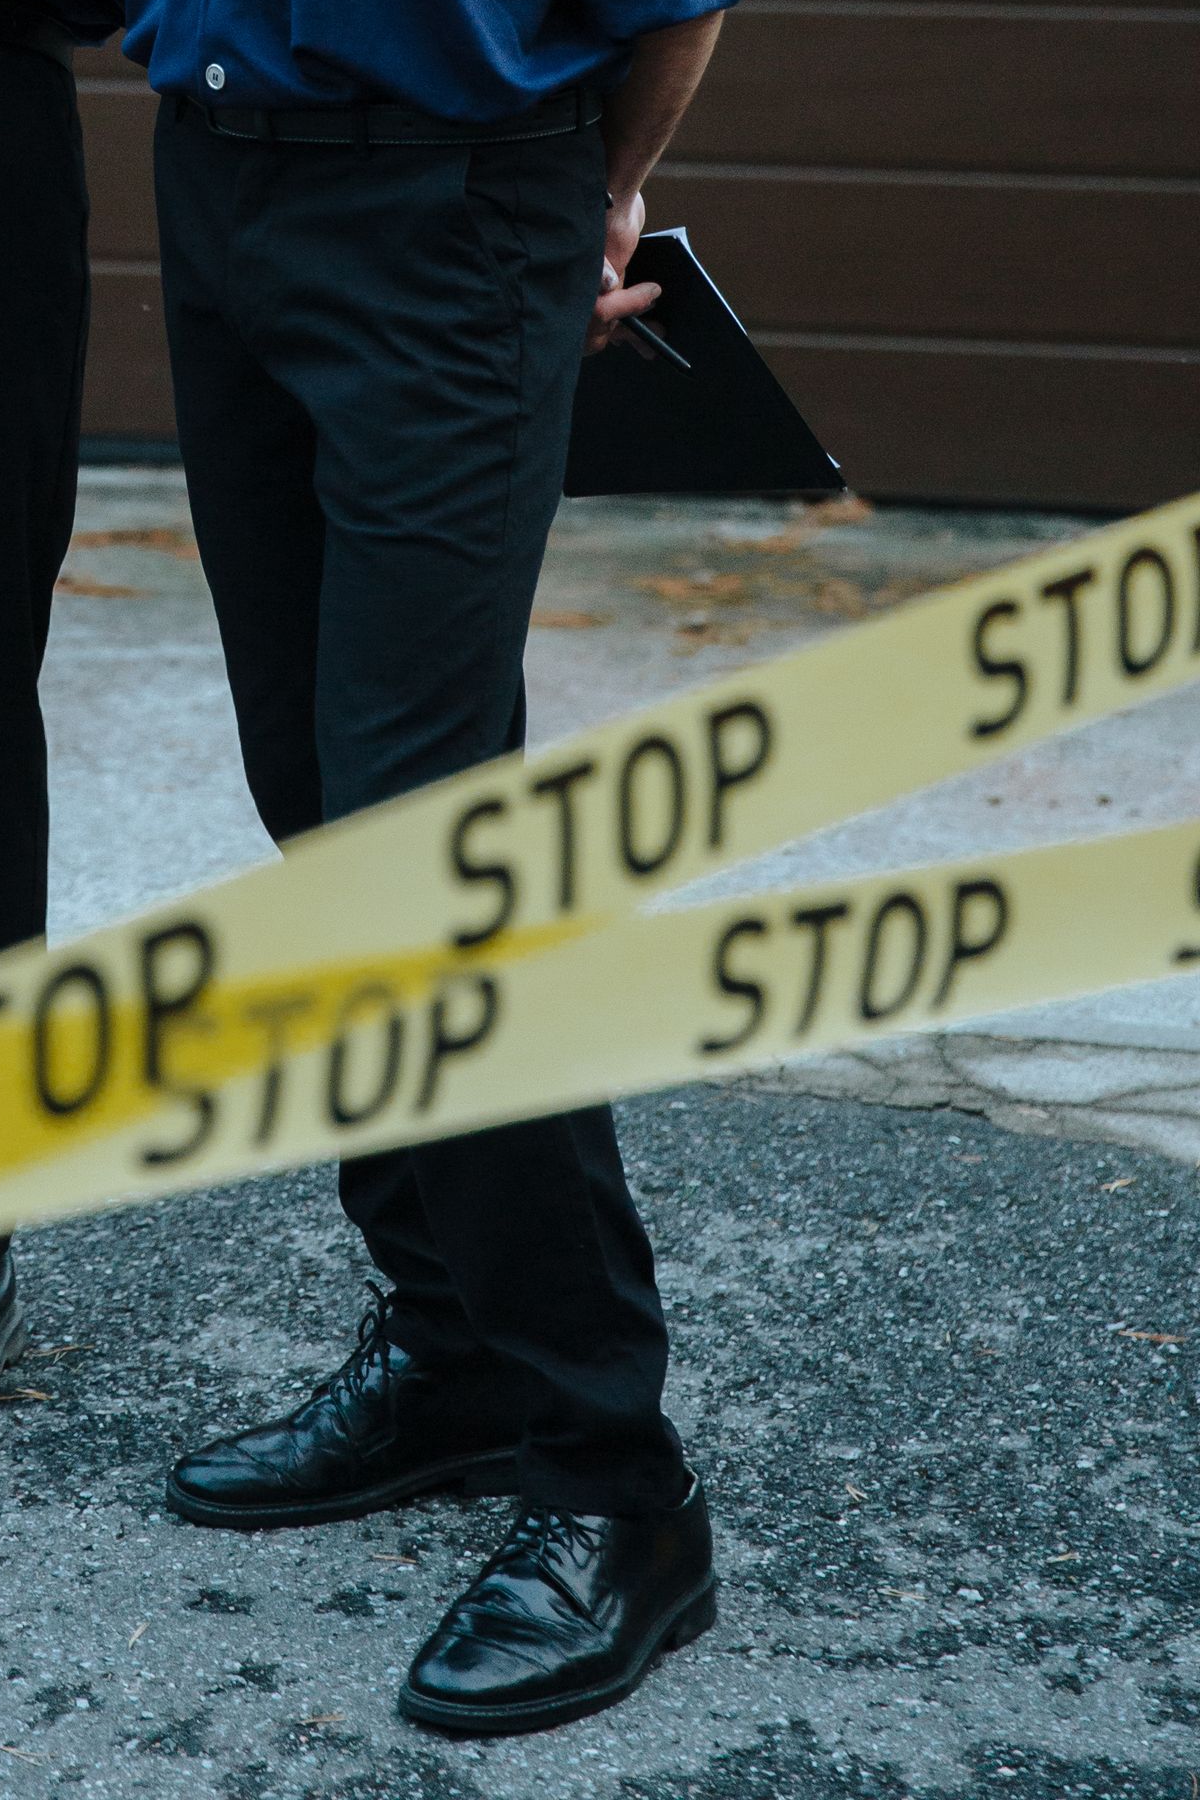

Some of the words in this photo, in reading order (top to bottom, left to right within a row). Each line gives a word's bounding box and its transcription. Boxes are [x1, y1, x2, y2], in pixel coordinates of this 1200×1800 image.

[970, 526, 1200, 742] STO
[448, 698, 775, 948] STOP
[700, 880, 1009, 1057] STOP
